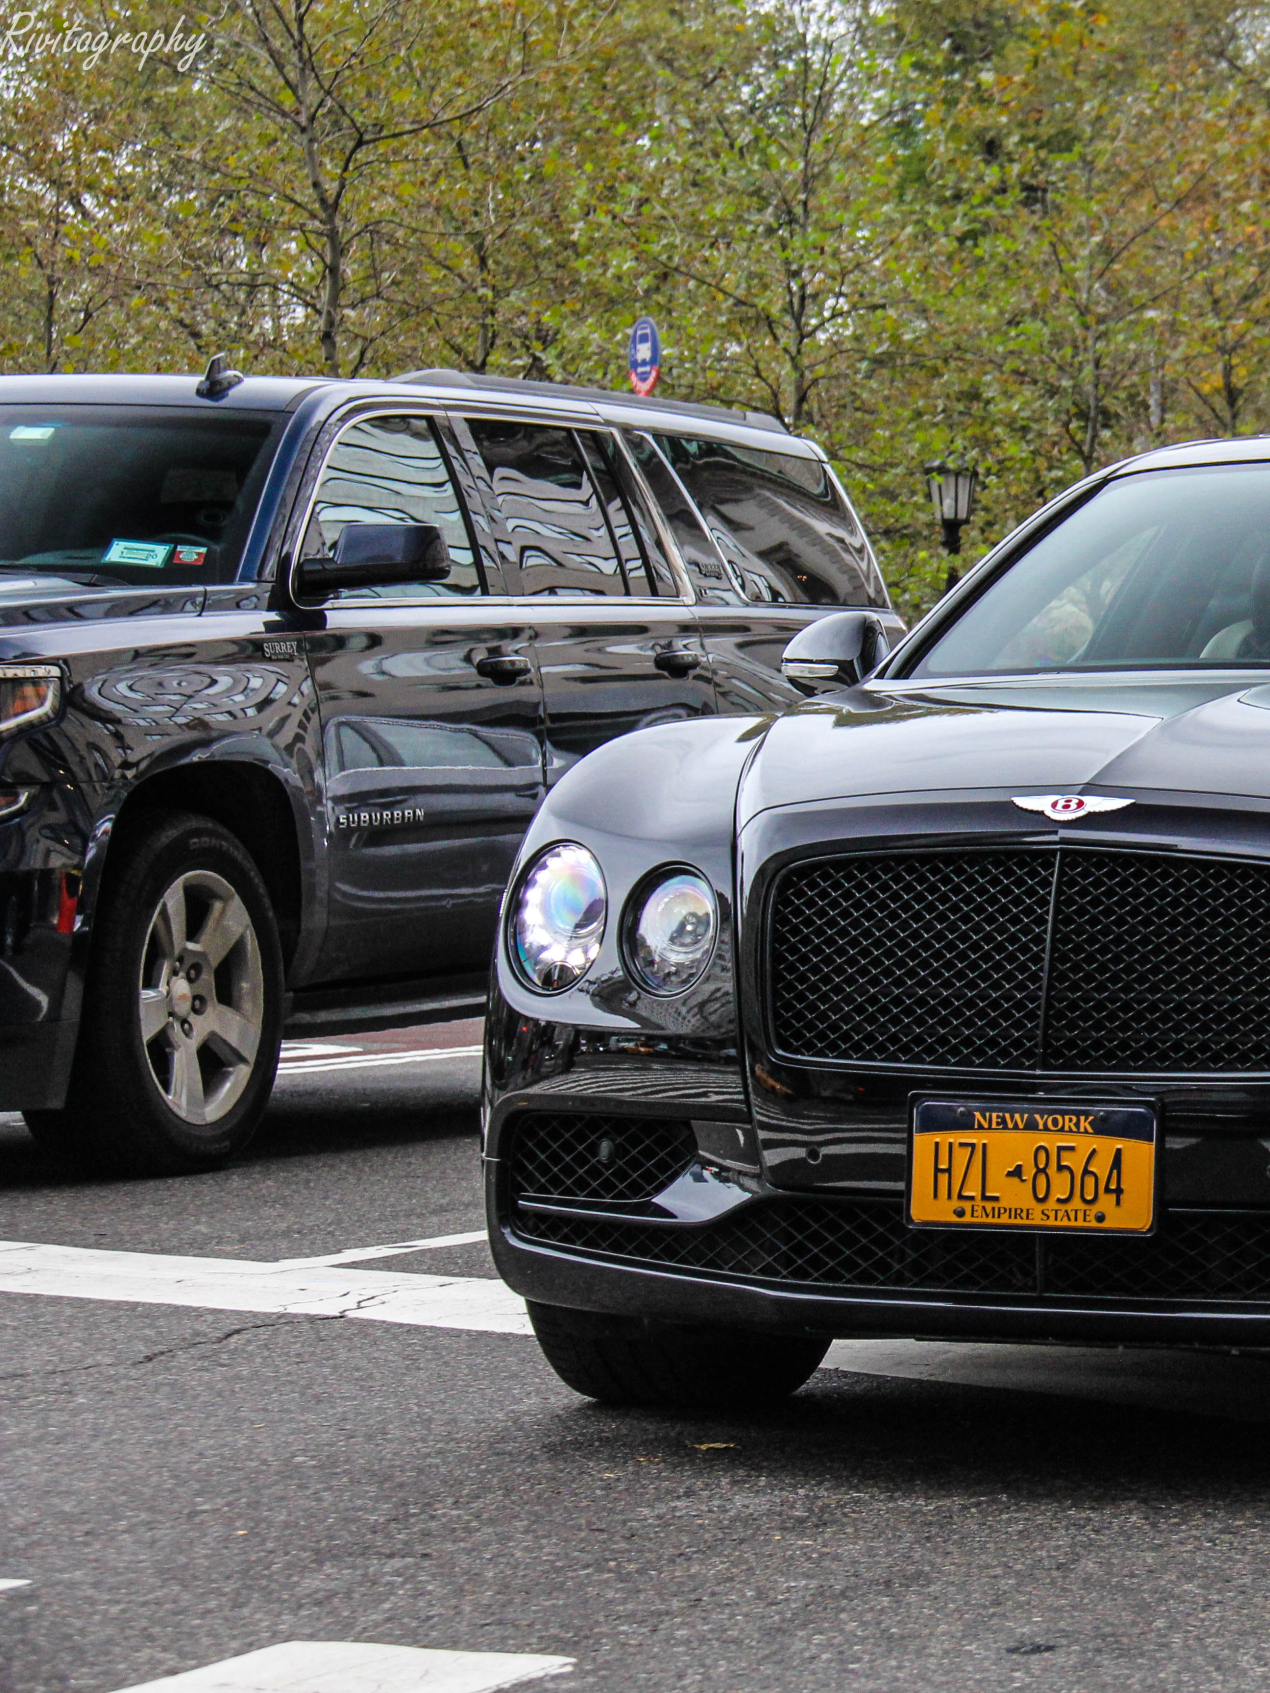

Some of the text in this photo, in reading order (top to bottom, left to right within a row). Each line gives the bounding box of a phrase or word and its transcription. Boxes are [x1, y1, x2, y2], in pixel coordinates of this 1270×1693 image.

[263, 641, 298, 657] SURREY
[338, 808, 424, 828] SUBURBAN
[973, 1111, 1095, 1133] NEW YORK
[933, 1138, 1124, 1206] HZL 8564
[970, 1204, 1092, 1223] EMPIRE STATE
